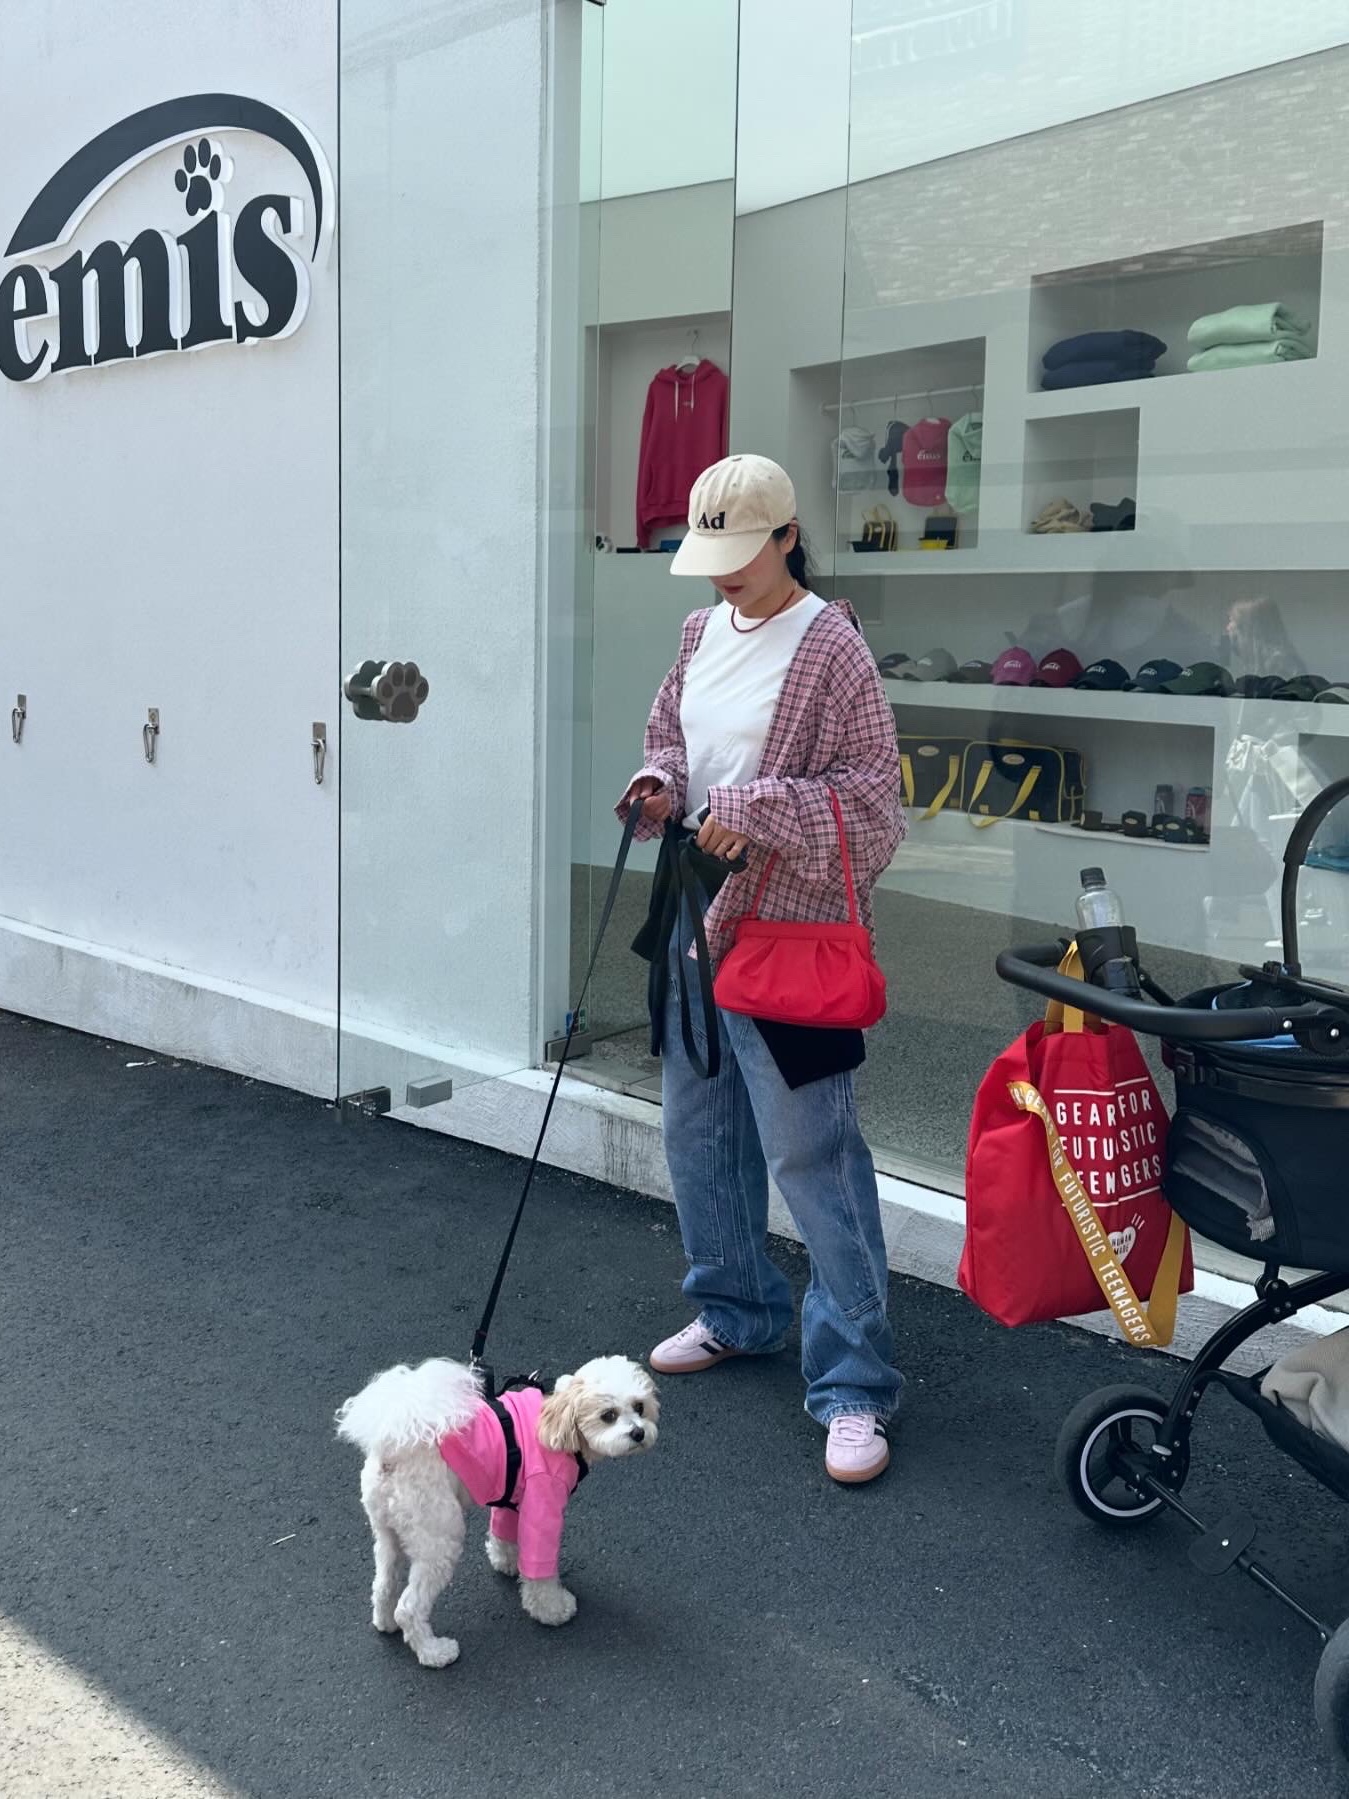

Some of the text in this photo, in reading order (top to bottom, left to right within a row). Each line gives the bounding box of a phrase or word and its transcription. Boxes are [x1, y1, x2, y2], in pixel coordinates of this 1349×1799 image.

[0, 140, 299, 382] emis
[697, 511, 726, 530] Ad
[1056, 1089, 1152, 1127] GEAR FOR
[1059, 1122, 1156, 1161] FUTUISTIC
[1059, 1172, 1107, 1257] FUTURISTIC
[1099, 1259, 1151, 1343] TEENAGERS
